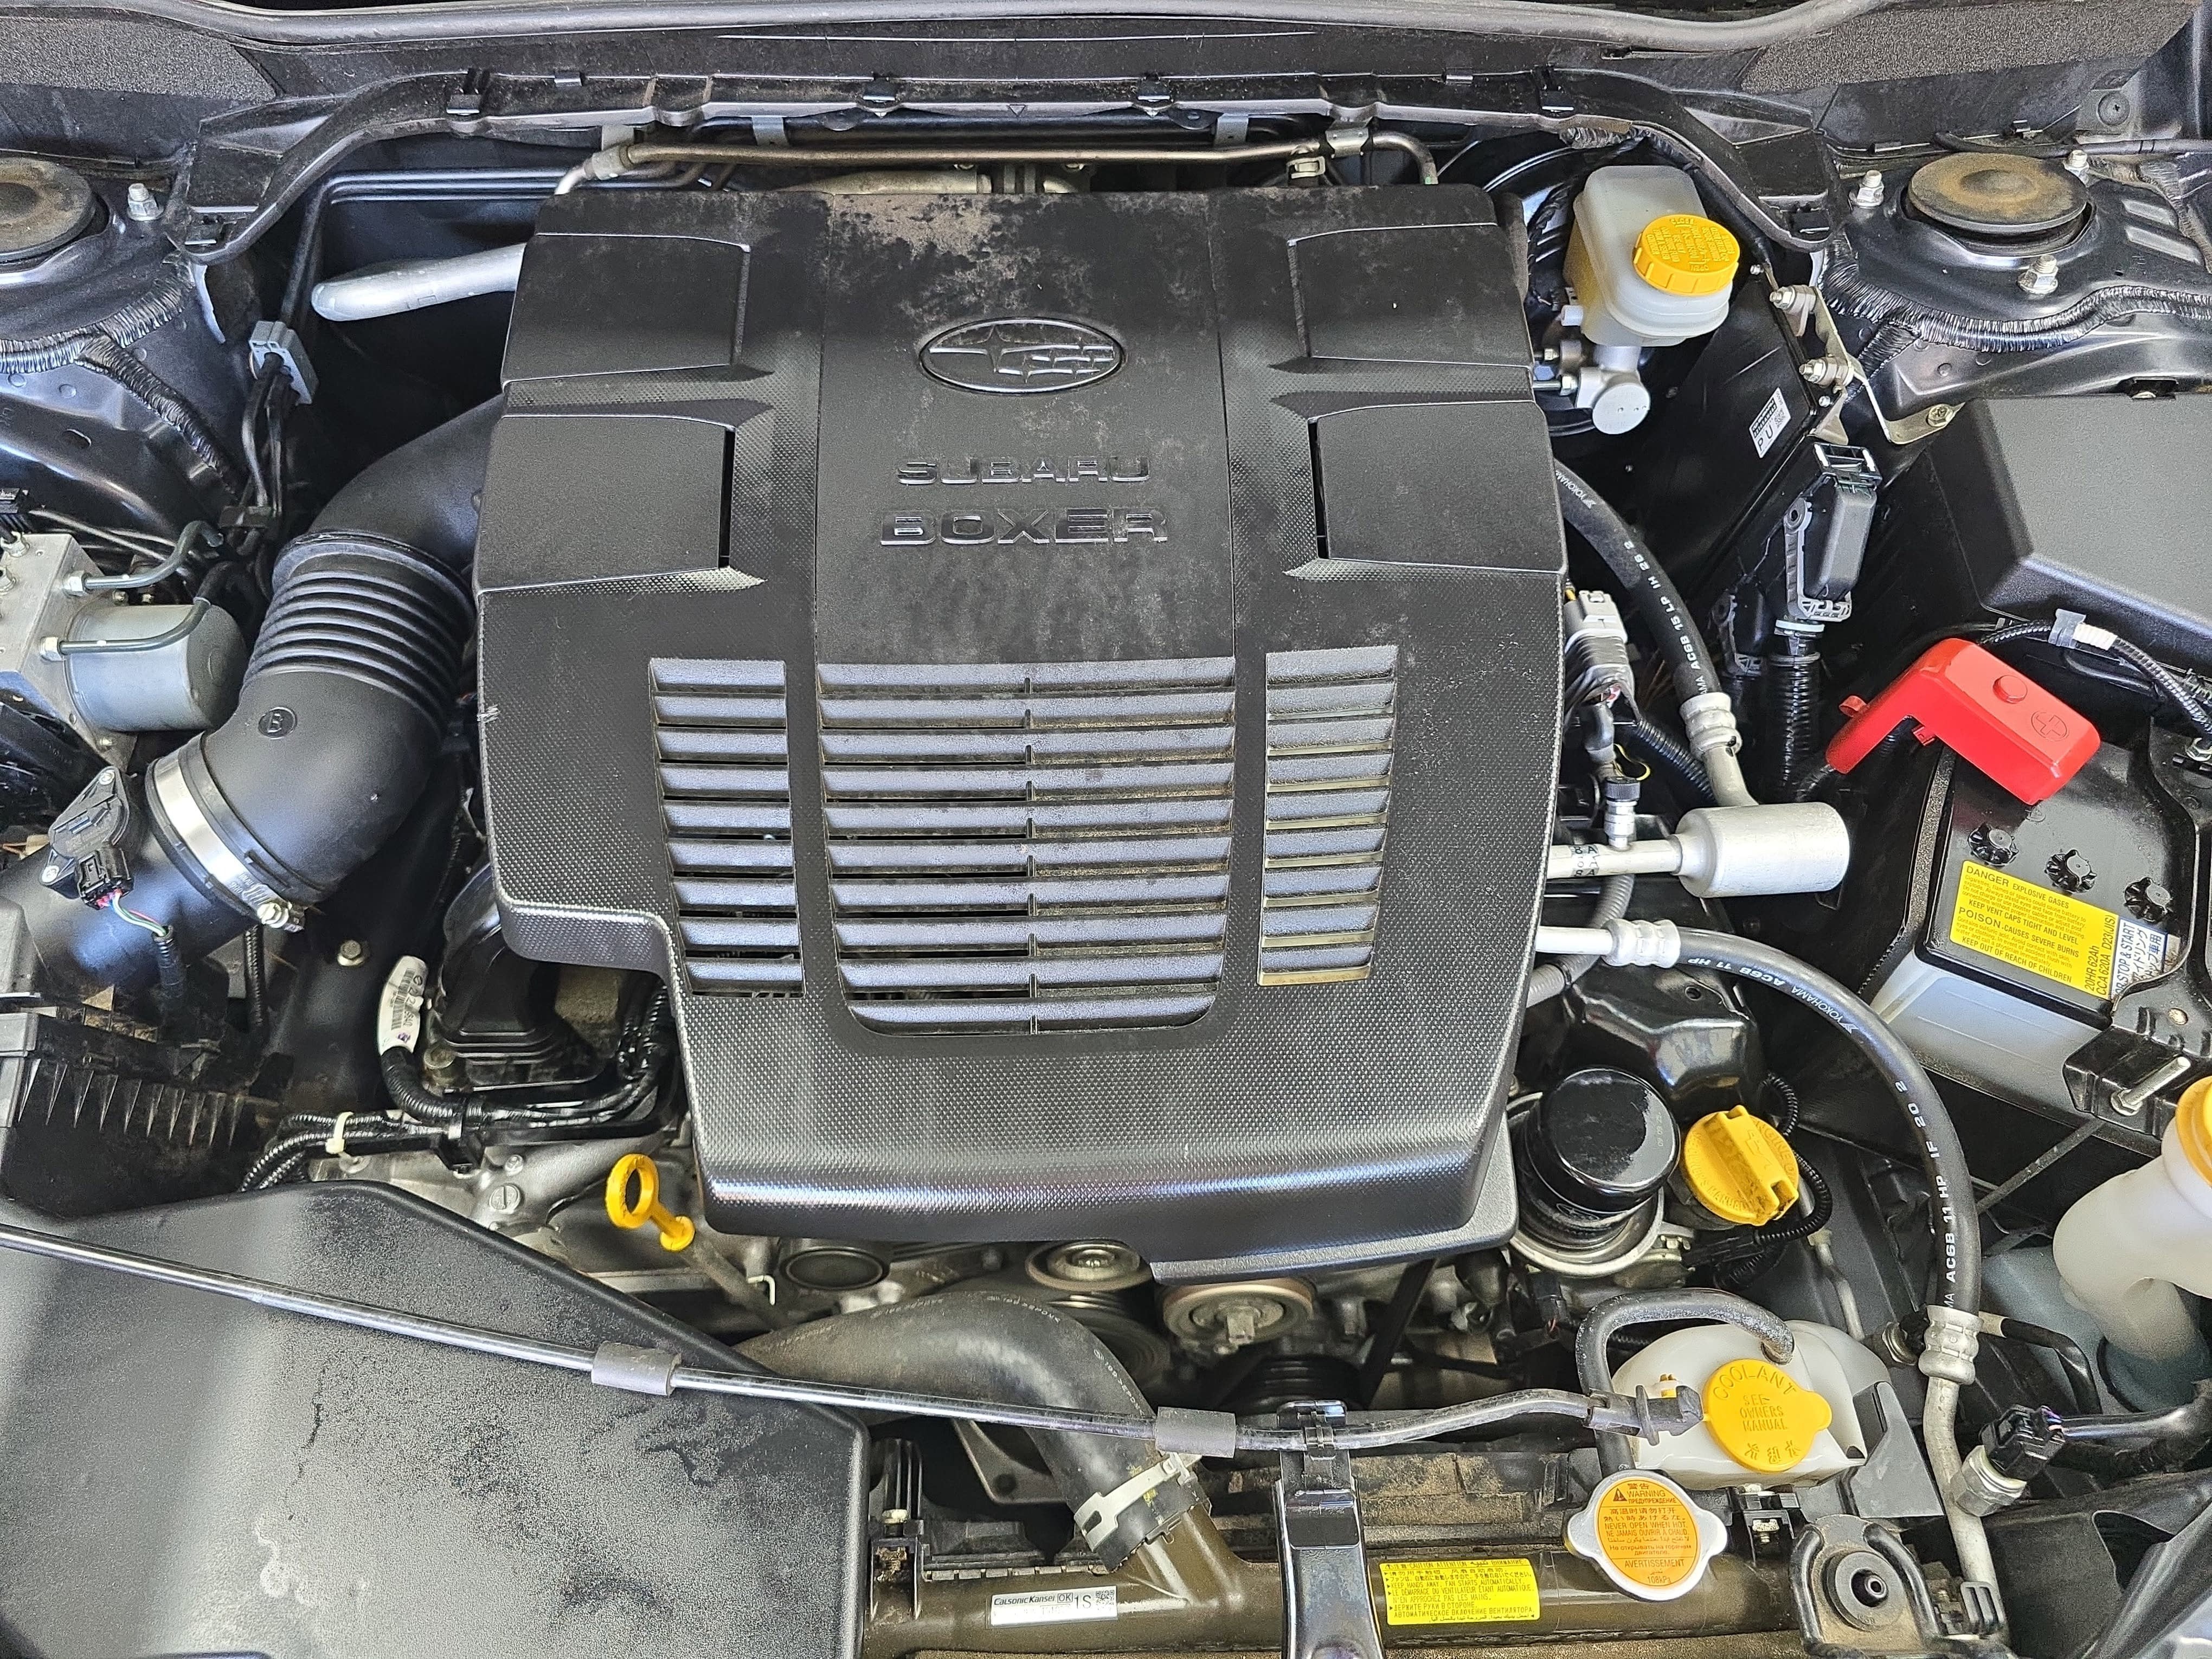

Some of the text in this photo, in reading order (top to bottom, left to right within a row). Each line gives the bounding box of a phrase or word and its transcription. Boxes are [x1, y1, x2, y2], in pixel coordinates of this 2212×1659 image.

[1757, 437, 1764, 452] P
[1765, 425, 1773, 440] U
[897, 456, 1150, 485] SUBARU
[880, 508, 1168, 545] BOXER
[267, 710, 283, 734] B
[1966, 865, 2069, 909] DANGER EXPLOSIVE GASES
[1958, 906, 2001, 929] POISON
[2031, 934, 2055, 949] SEVERE
[2056, 943, 2079, 958] BURNS
[1968, 898, 2079, 945] KEEP VENT CAPS TIGHT AND LEVEL
[2119, 922, 2136, 951] START
[1688, 957, 1712, 968] HP
[1962, 935, 2072, 983] KEEP OUT OF REACH OF CHILDREN
[2095, 913, 2117, 996] CCA 620A D23(JIS)
[2119, 950, 2131, 959] &
[1739, 966, 1786, 987] AC6B
[2082, 944, 2100, 992] 20HR 62Ah
[2115, 957, 2131, 983] STOP
[1790, 985, 1844, 1024] YOKOHAMA
[1907, 1103, 1927, 1128] 20
[1937, 1174, 1951, 1200] HP
[1945, 1231, 1957, 1284] AC6B
[1713, 1364, 1797, 1400] COOLANT
[1743, 1394, 1770, 1406] SEE
[1739, 1406, 1784, 1420] OWNERS
[1742, 1418, 1789, 1432] MANUAL
[1626, 1490, 1666, 1498] WARNING
[1624, 1559, 1684, 1568] AVERTISSEMENT
[1441, 1586, 1476, 1594] VENTILATEUR
[1647, 1576, 1671, 1584] 108kPa
[1058, 1593, 1072, 1603] OK
[1393, 1603, 1422, 1611] ДЕРЖИТЕ
[1409, 1594, 1441, 1603] APPROCHEZ
[1393, 1609, 1450, 1618] АВТОМАТИЧЕСКОЕ
[1451, 1607, 1488, 1616] ВКЛЮЧЕНИЕ
